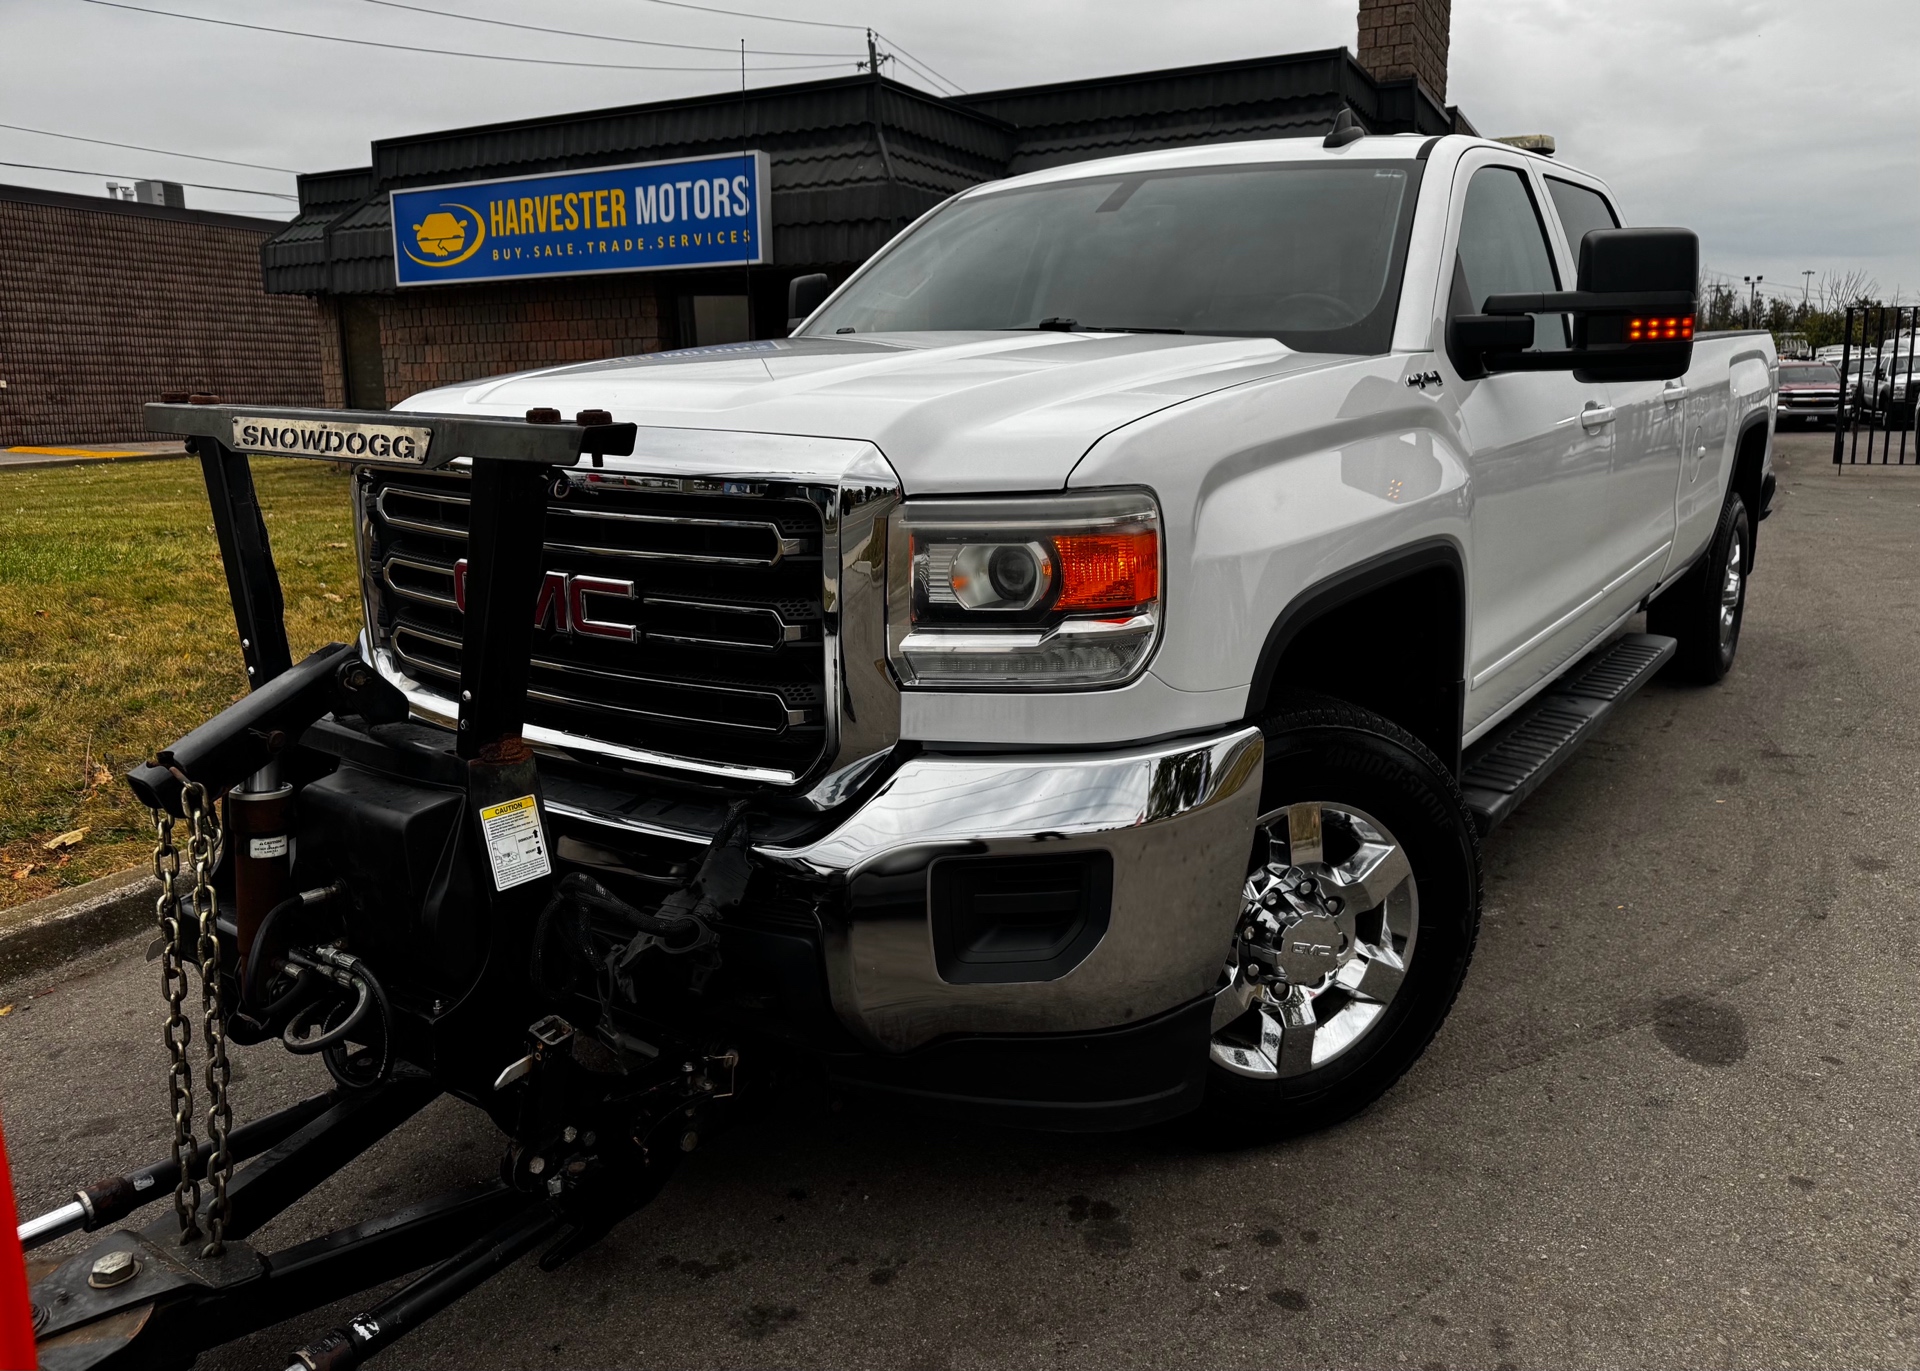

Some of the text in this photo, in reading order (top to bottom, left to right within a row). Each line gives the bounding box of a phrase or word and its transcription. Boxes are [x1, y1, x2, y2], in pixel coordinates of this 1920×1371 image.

[490, 175, 750, 237] HARVESTER MOTORS
[242, 425, 416, 459] SNOWDOGG
[453, 558, 642, 644] MC
[495, 801, 523, 815] CAUTION
[1291, 941, 1332, 957] GMC
